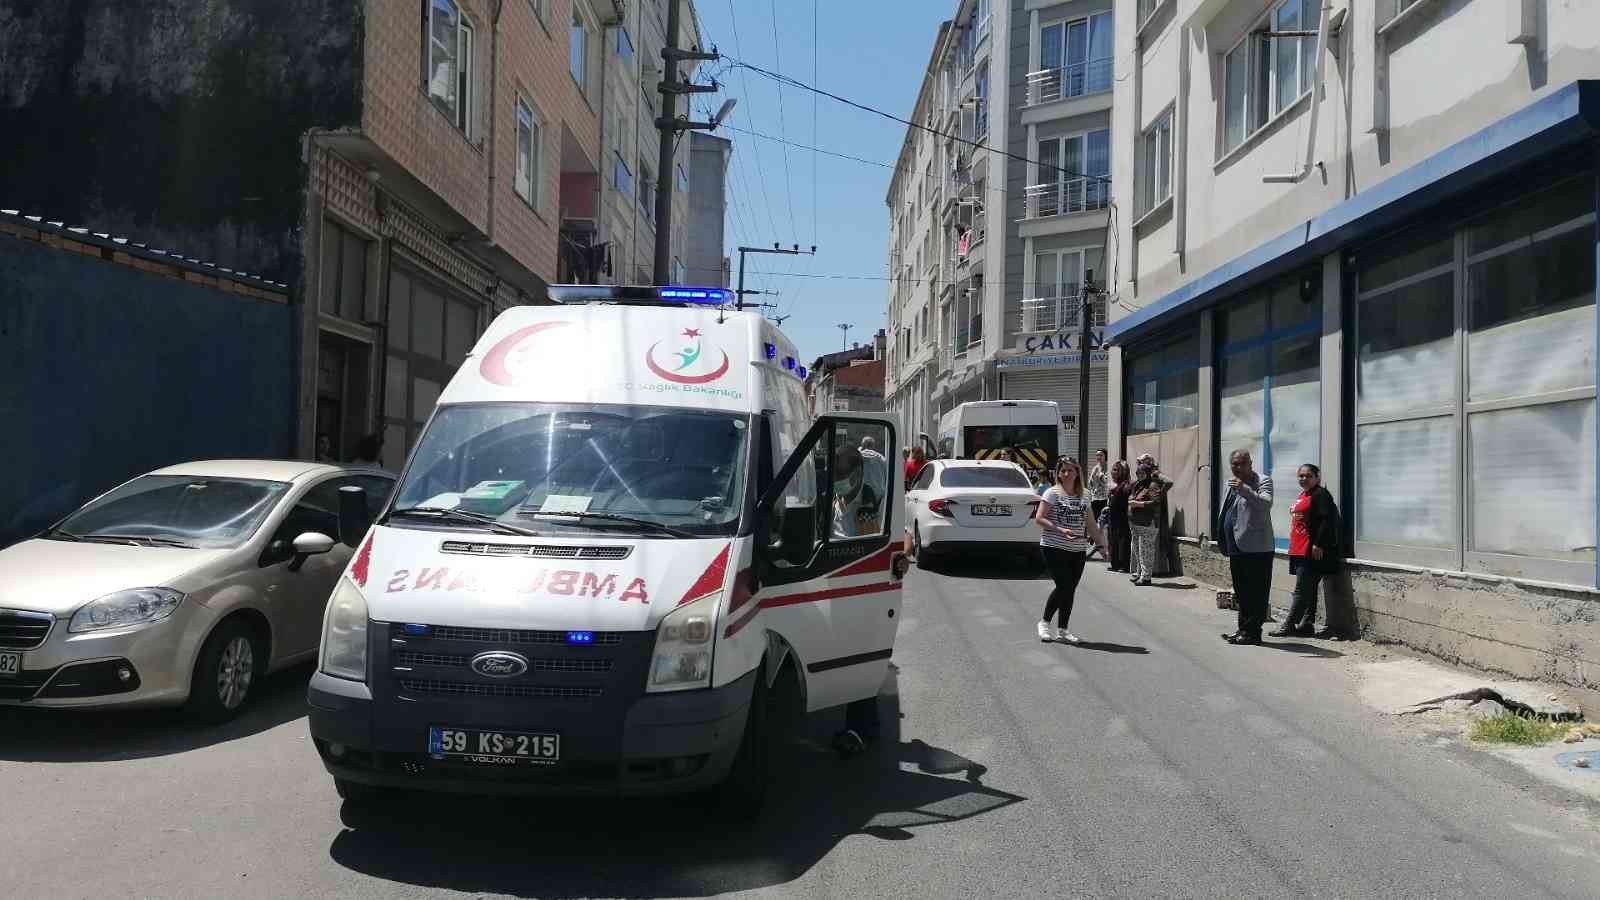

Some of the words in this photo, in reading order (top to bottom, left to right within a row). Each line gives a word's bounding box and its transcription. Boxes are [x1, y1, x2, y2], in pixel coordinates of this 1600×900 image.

[683, 384, 743, 400] Bakanlığı
[482, 658, 513, 672] Ford
[442, 731, 467, 751] 59
[479, 732, 504, 753] KS
[516, 735, 555, 756] 215
[471, 755, 516, 765] VOLKAN
